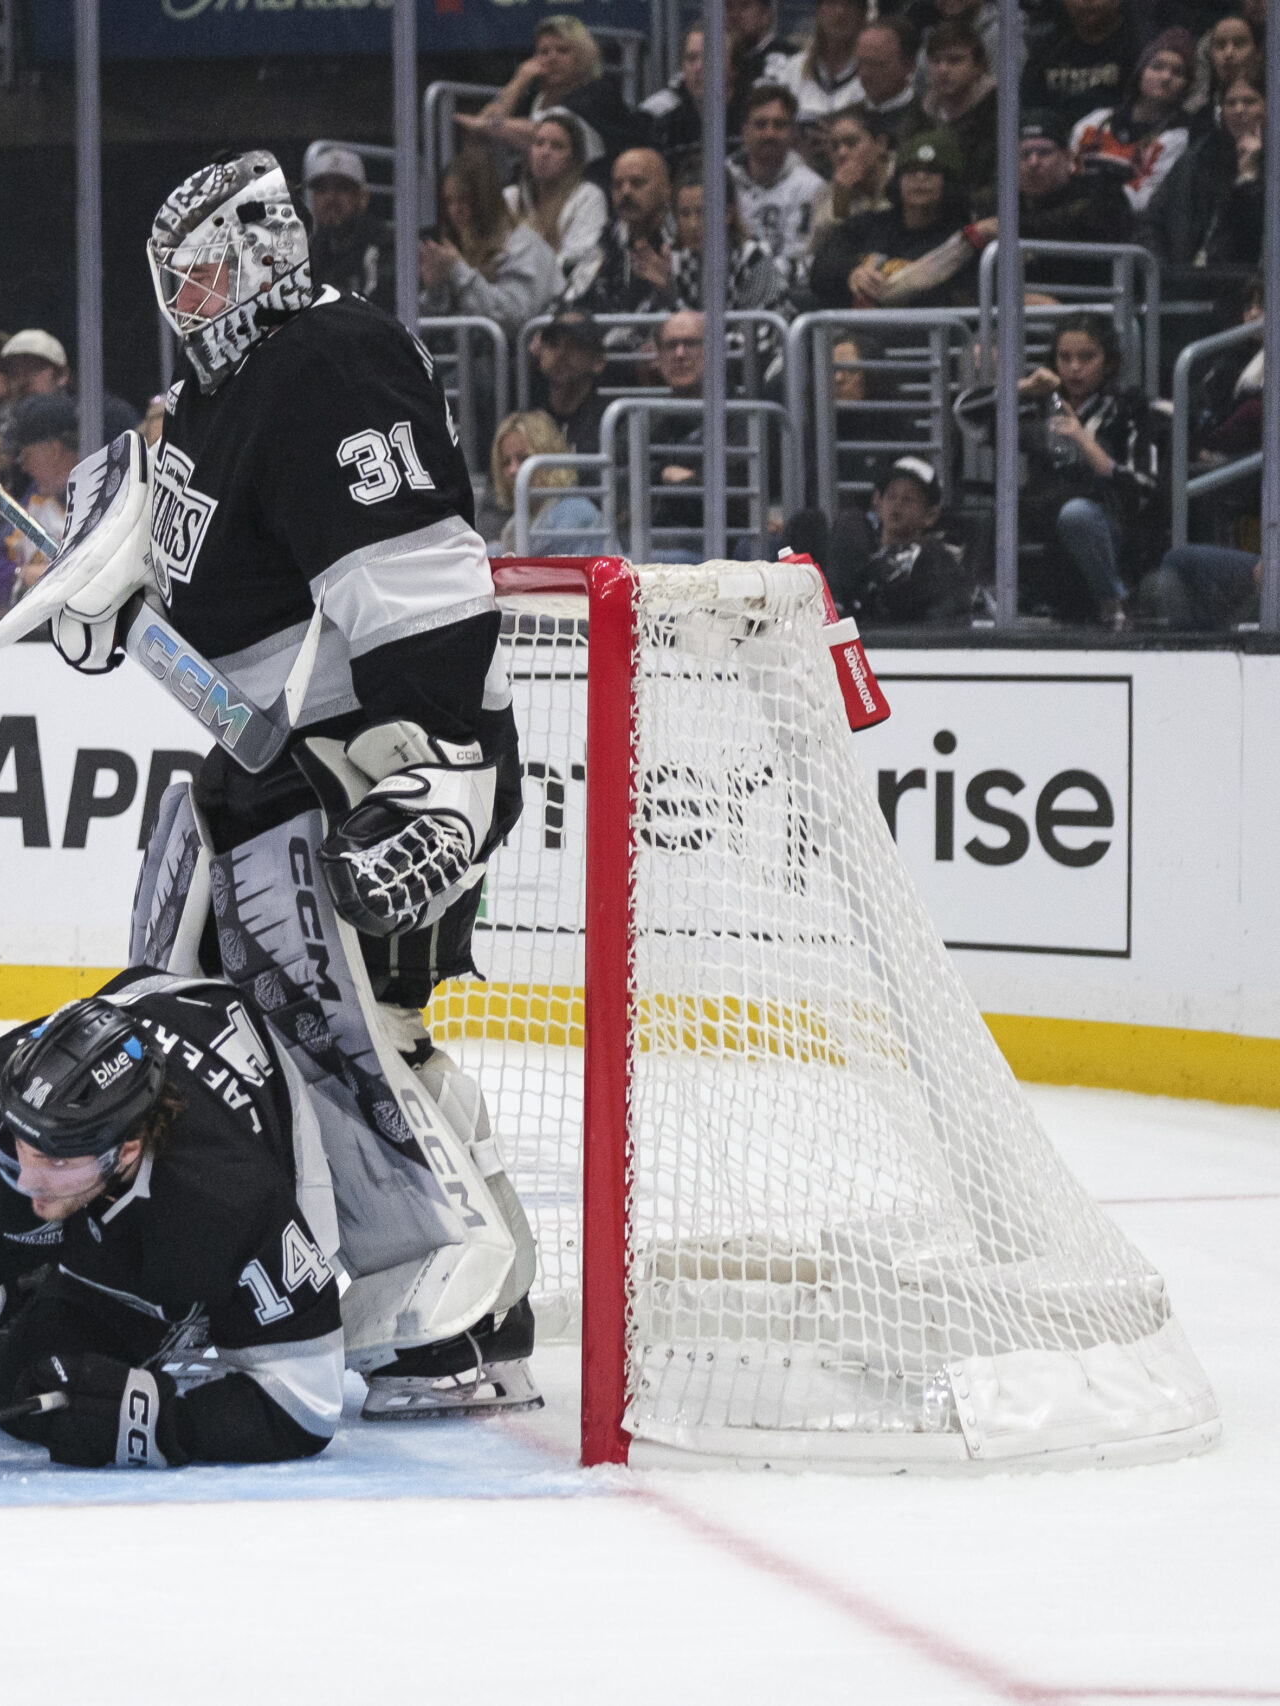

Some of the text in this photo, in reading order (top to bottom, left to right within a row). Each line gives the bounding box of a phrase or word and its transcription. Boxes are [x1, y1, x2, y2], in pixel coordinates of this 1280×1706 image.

[337, 421, 436, 506] 31
[138, 624, 253, 749] CCM
[843, 647, 877, 714] BODYARMOR
[456, 751, 481, 761] CCM
[289, 836, 342, 1002] CCM
[22, 1075, 54, 1111] 14
[91, 1051, 131, 1085] blue
[400, 1088, 487, 1229] CCM
[238, 1219, 335, 1327] 14
[127, 1389, 150, 1464] CC
